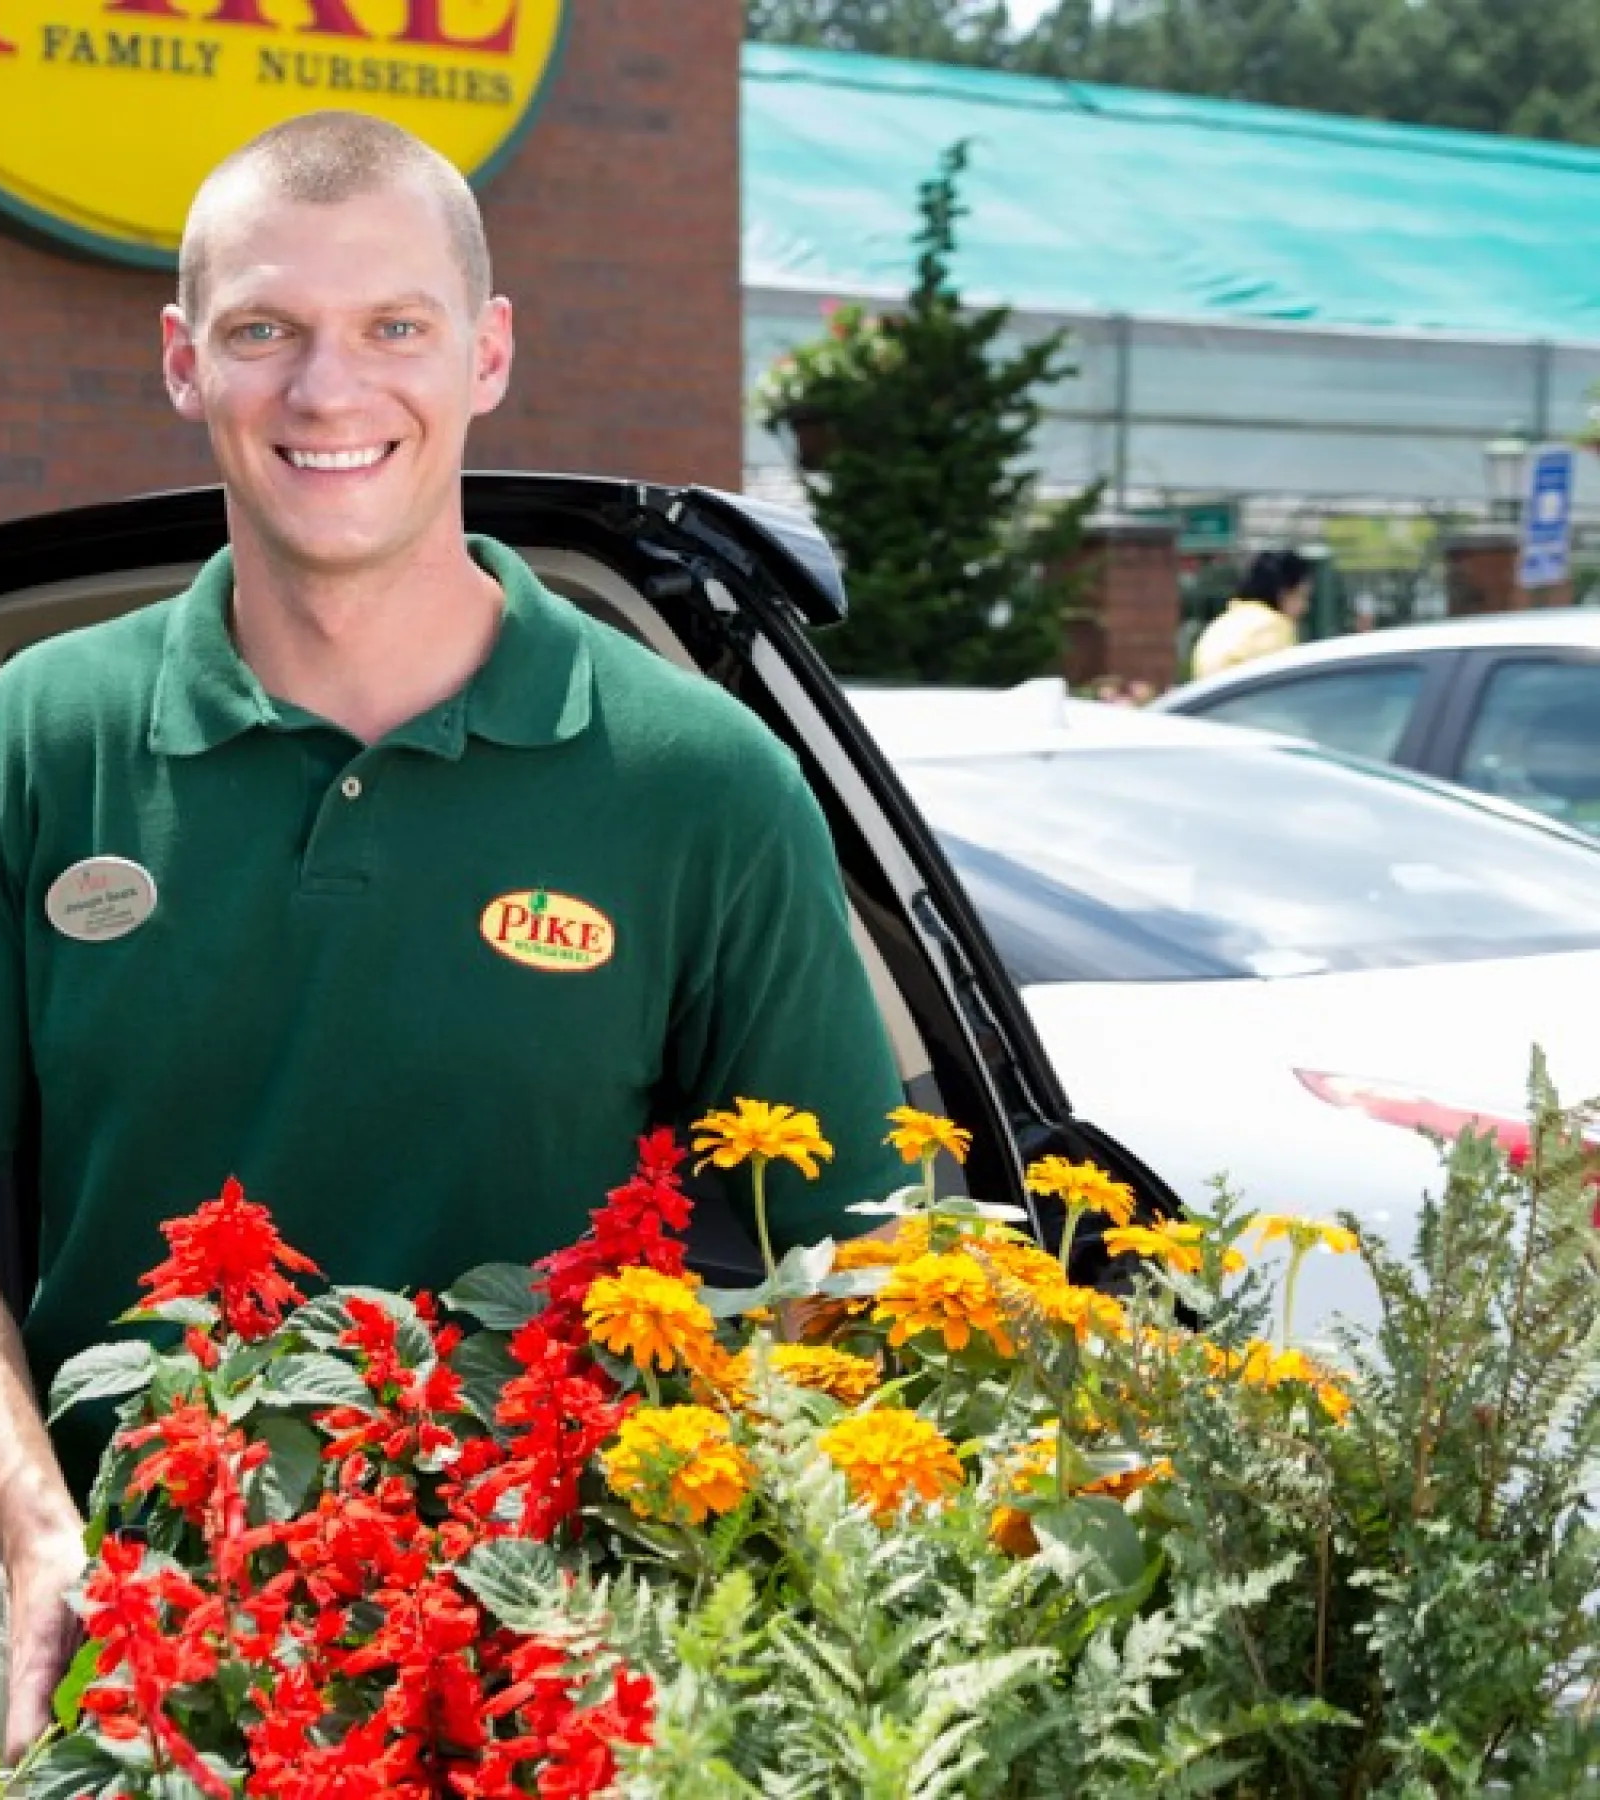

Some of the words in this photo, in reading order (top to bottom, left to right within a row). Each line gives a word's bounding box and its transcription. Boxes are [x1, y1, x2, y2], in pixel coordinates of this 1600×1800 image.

[40, 24, 222, 76] FAMILY
[258, 46, 513, 106] NURSERIES
[496, 902, 605, 953] PIKE
